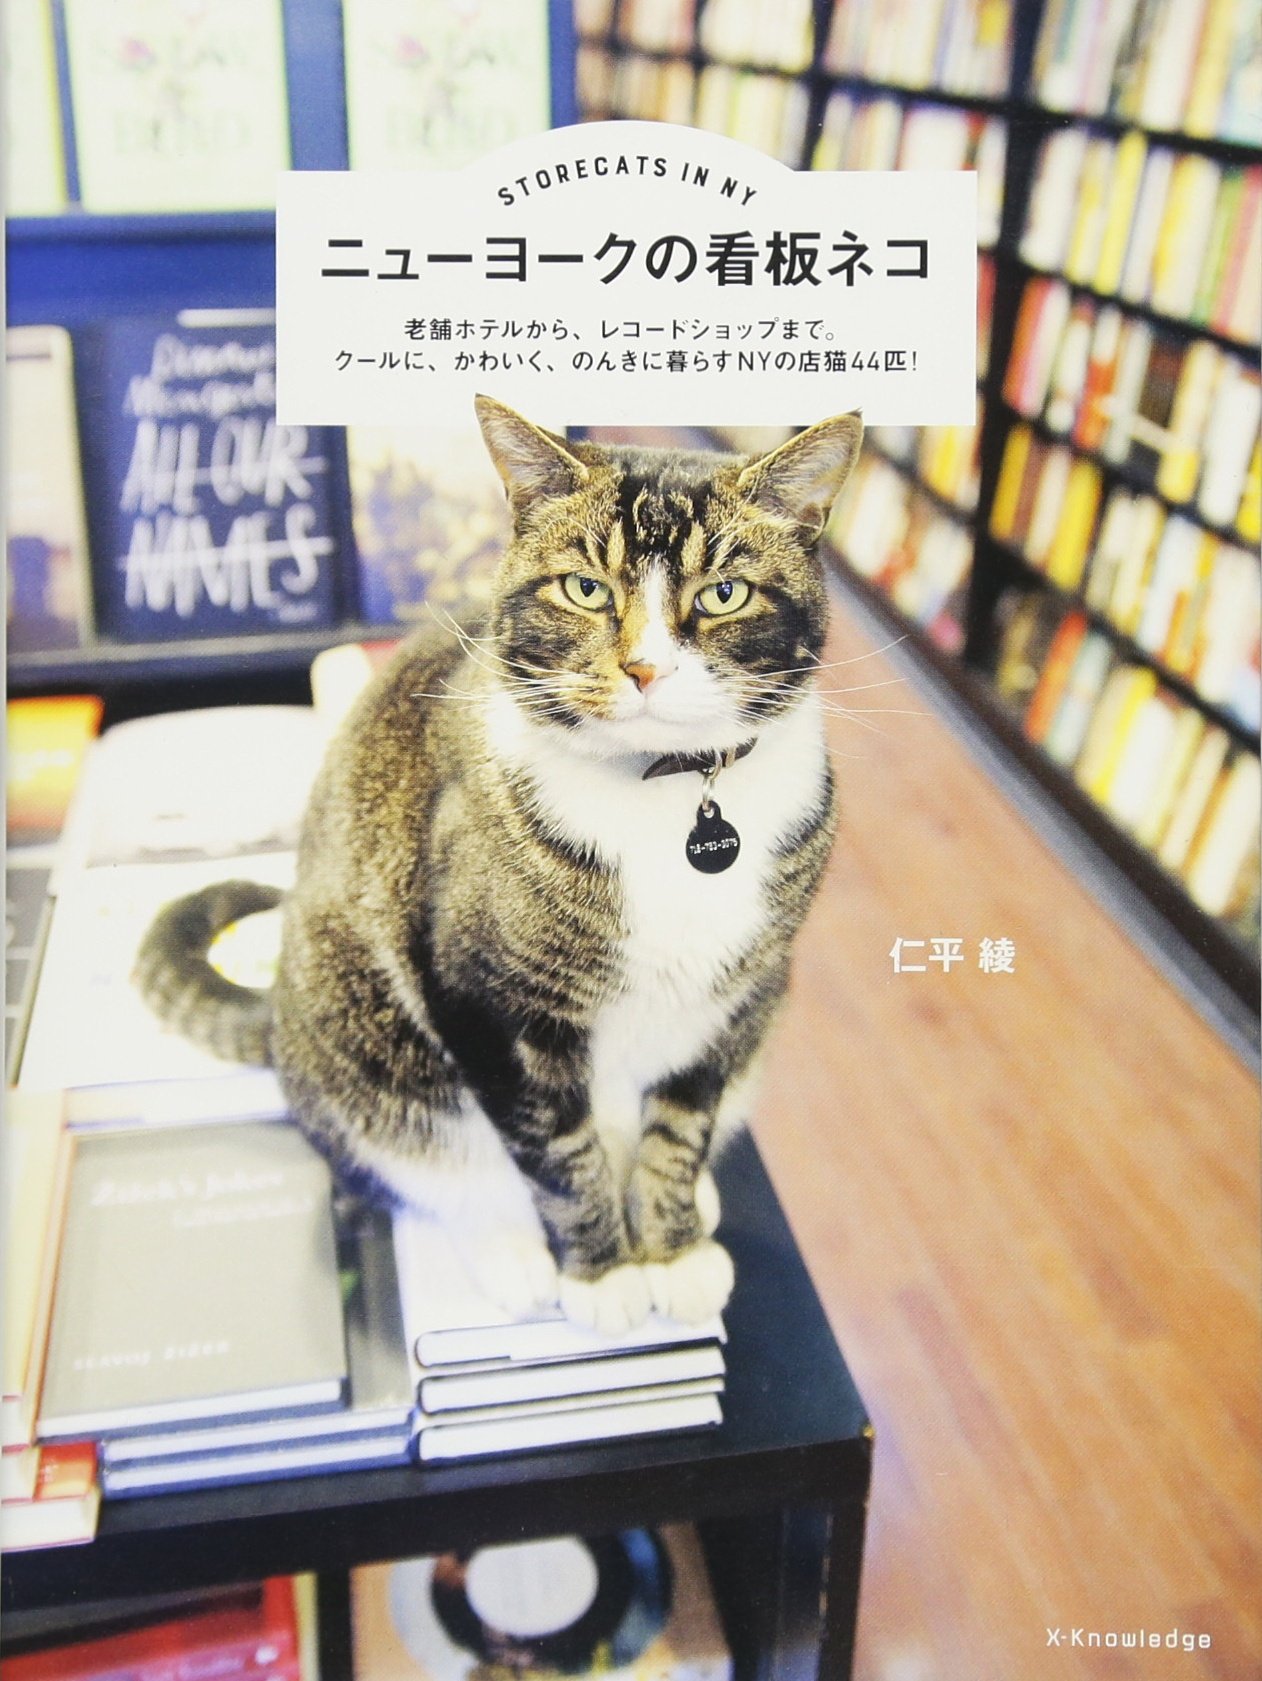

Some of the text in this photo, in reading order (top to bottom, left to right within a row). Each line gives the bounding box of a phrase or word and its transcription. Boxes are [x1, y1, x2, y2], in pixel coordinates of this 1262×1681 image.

[498, 155, 757, 207] STORECATS IN NY
[321, 230, 929, 287] ニューヨークの看板ネコ
[889, 936, 1016, 974] 仁平 綾
[1045, 1627, 1212, 1652] X-Knowledge
